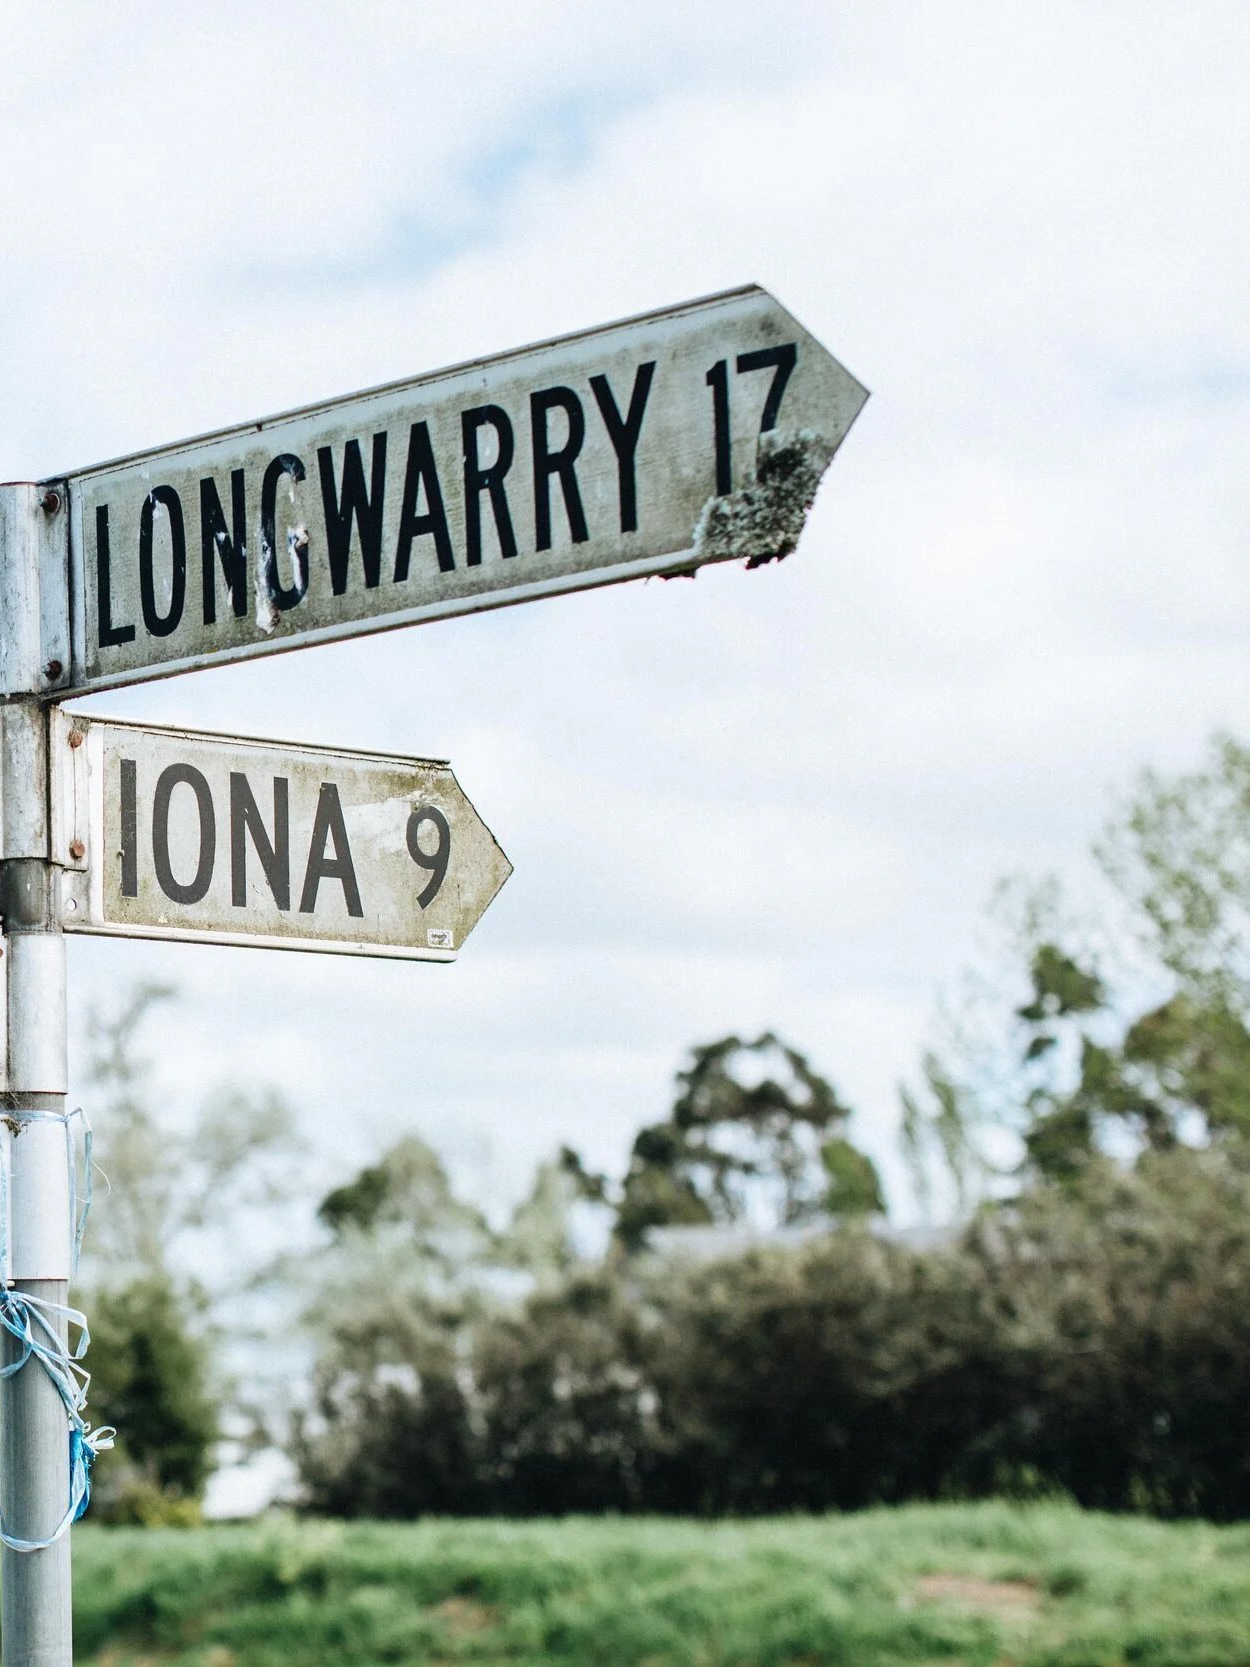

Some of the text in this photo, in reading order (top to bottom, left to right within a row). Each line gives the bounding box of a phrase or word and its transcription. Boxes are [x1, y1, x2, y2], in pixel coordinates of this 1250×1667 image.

[95, 343, 797, 648] LONGWARRY 17
[120, 758, 451, 917] IONA 9
